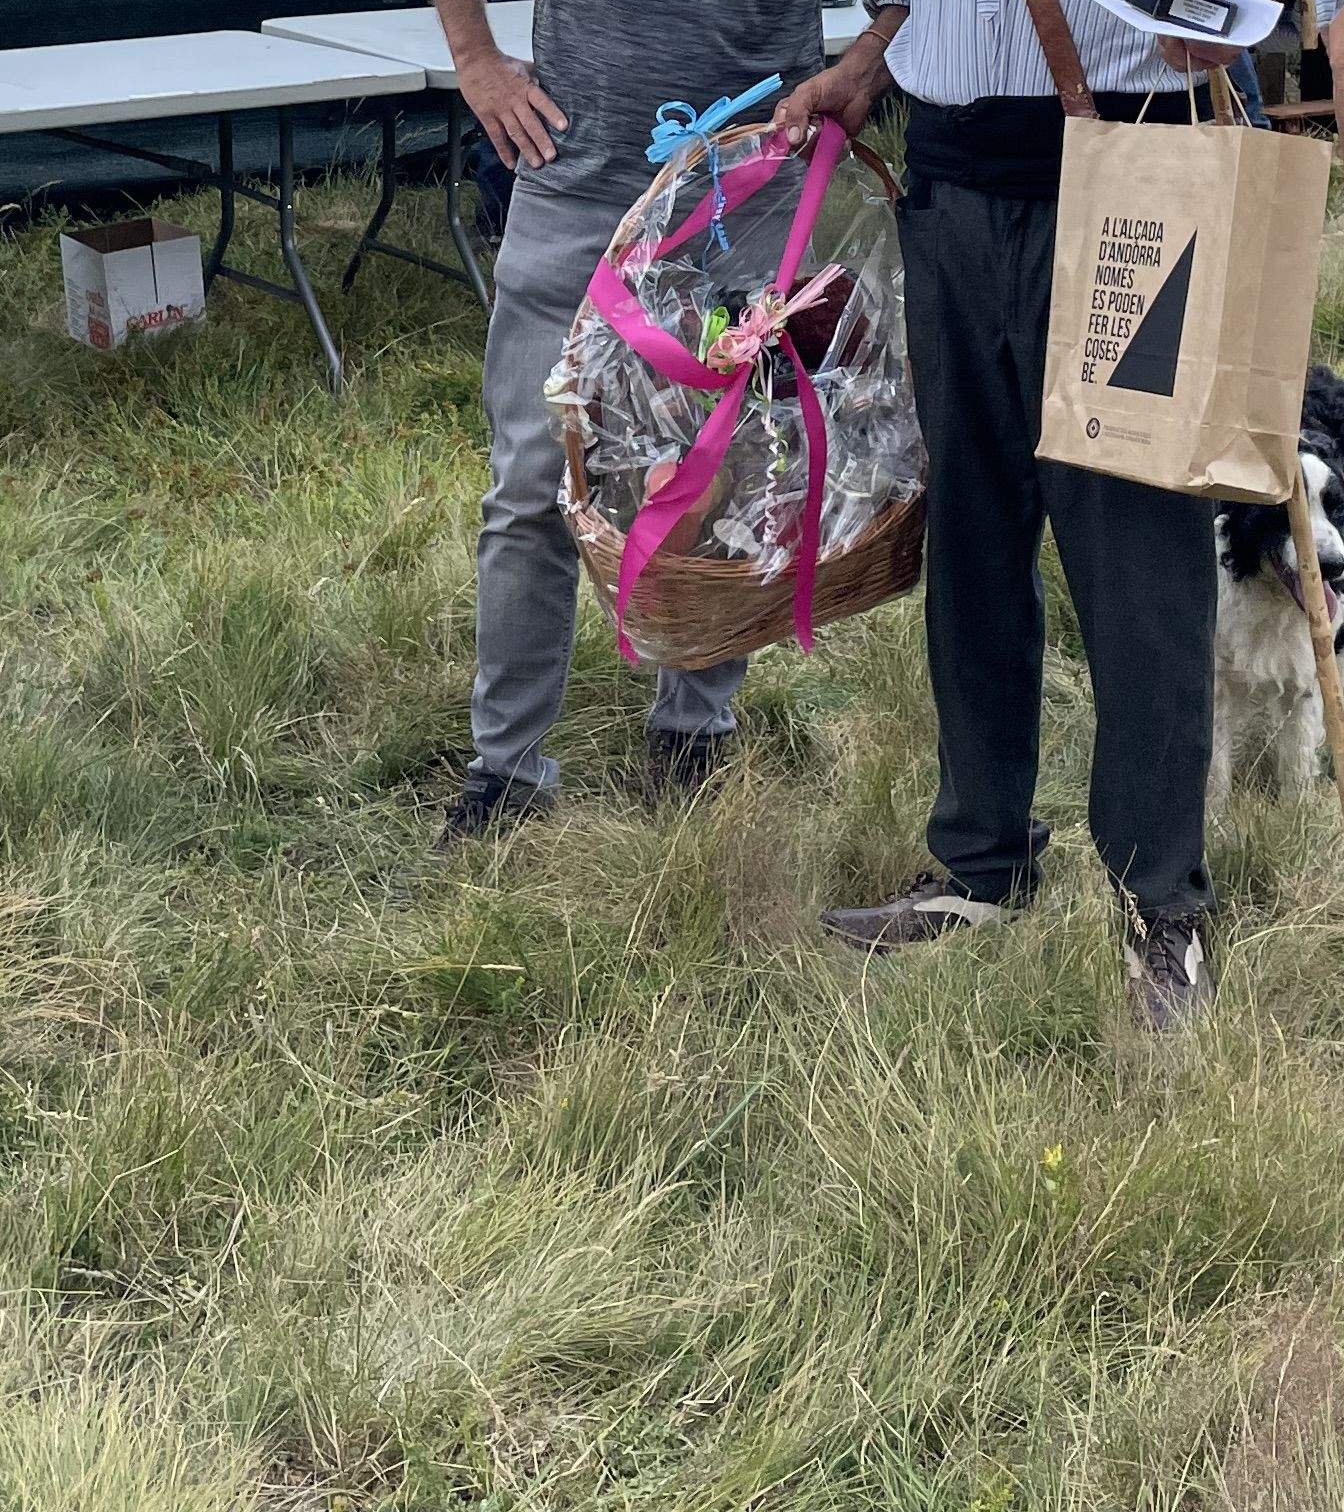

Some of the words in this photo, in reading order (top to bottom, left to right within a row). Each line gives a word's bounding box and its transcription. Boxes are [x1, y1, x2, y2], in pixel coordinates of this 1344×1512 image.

[1101, 216, 1110, 237] A
[1112, 217, 1164, 243] L'ALÇADA
[1098, 240, 1162, 268] D'ANDORRA
[1094, 263, 1135, 289] NOMÉS
[1091, 288, 1106, 310] ES
[1107, 291, 1146, 316] PODEN
[1087, 313, 1109, 336] FER
[1110, 316, 1132, 339] LES
[1084, 337, 1120, 362] COSES
